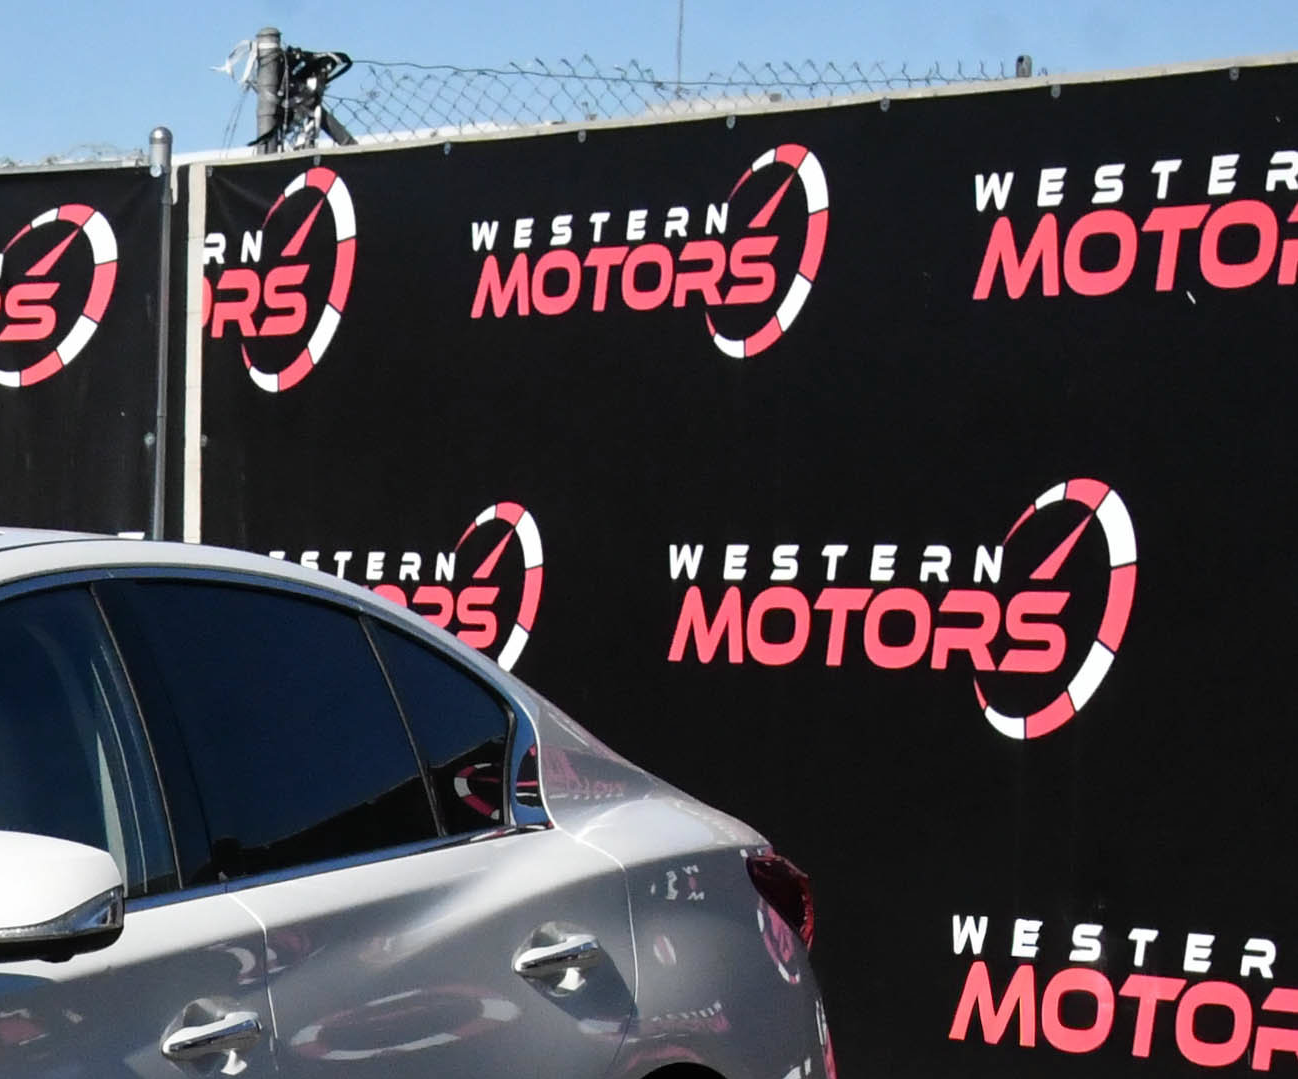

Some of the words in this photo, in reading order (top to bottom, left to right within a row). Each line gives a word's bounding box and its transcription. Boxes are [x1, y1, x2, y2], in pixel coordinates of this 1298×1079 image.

[472, 203, 728, 251] WESTERN
[973, 200, 1298, 300] MOTO
[471, 236, 778, 318] MOTORS
[670, 544, 1003, 583] WESTERN
[668, 586, 1070, 673] MOTORS
